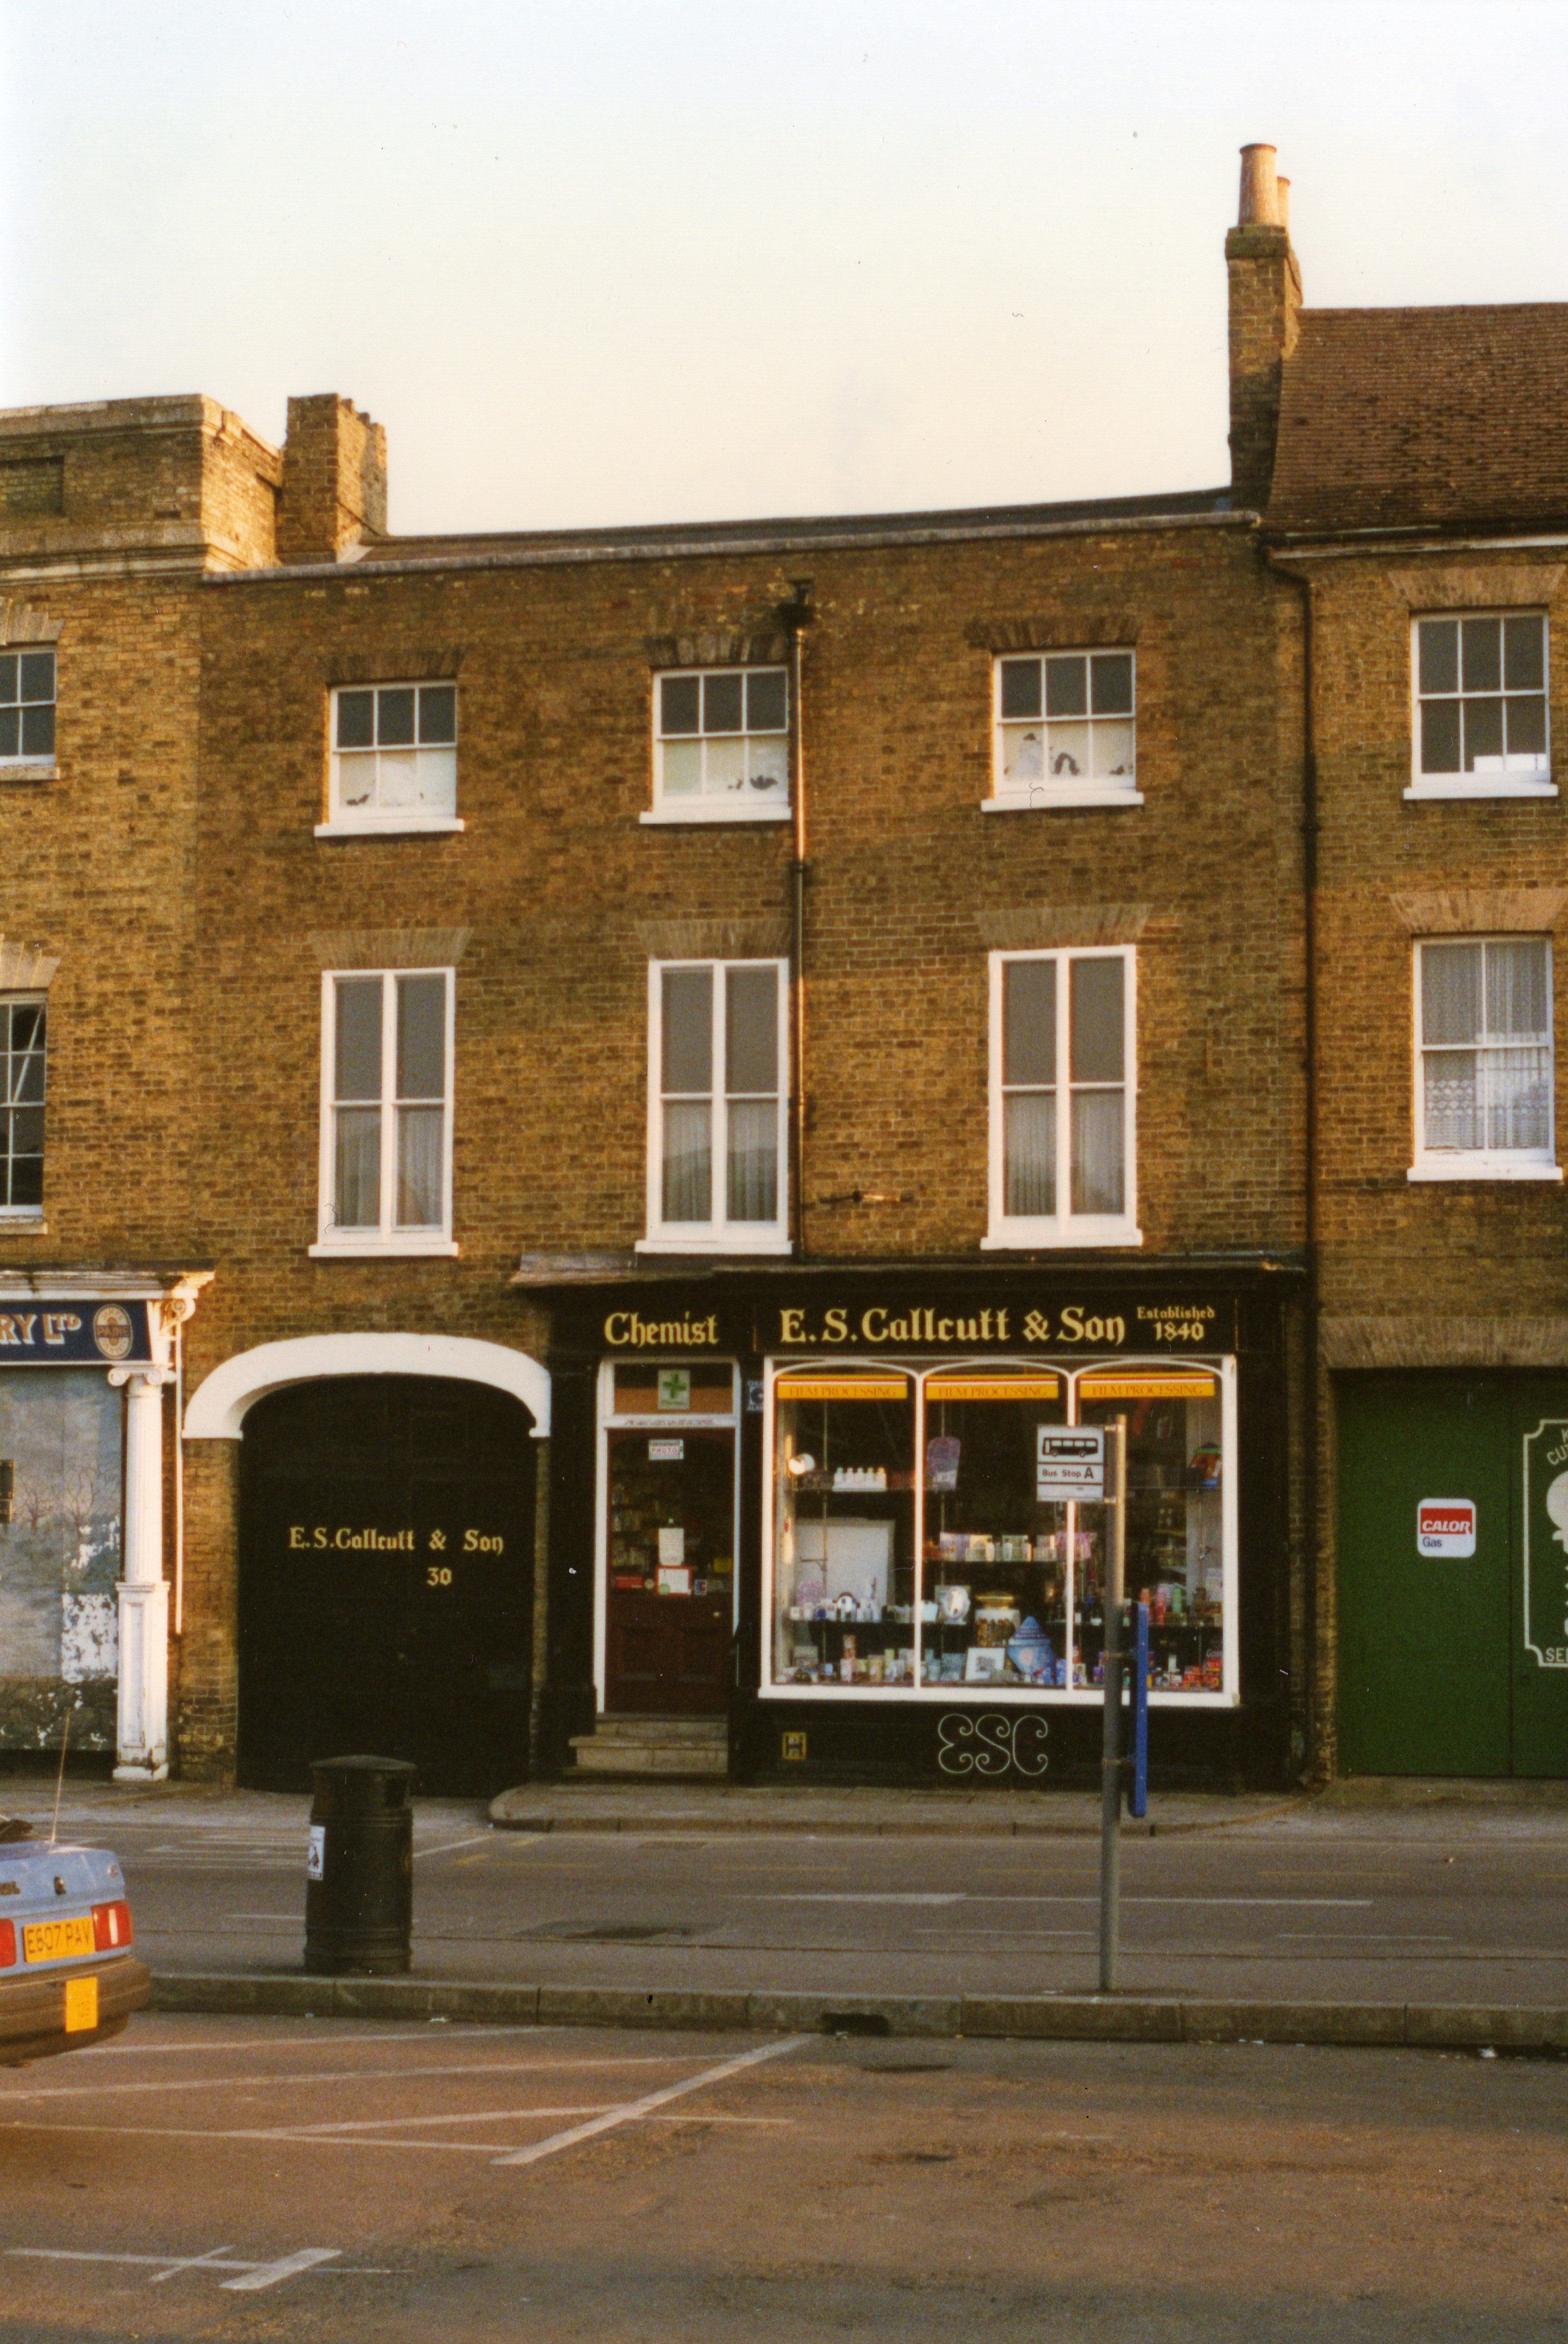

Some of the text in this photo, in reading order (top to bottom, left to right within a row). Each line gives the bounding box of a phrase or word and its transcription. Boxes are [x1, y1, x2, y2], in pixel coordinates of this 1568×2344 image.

[1137, 1306, 1216, 1320] Established
[604, 1311, 719, 1348] Chemist
[1022, 1309, 1050, 1342] &
[1056, 1306, 1125, 1346] Son
[1153, 1321, 1204, 1341] 1840
[822, 1386, 896, 1396] PROCESSING
[971, 1386, 1047, 1396] PROCESSING
[1126, 1384, 1203, 1395] PROCESSING
[1042, 1466, 1094, 1480] Bus Stop A
[1422, 1520, 1470, 1534] CALOR
[429, 1528, 446, 1550] &
[463, 1529, 504, 1554] Son
[1422, 1536, 1442, 1548] Gas
[426, 1567, 452, 1586] 30
